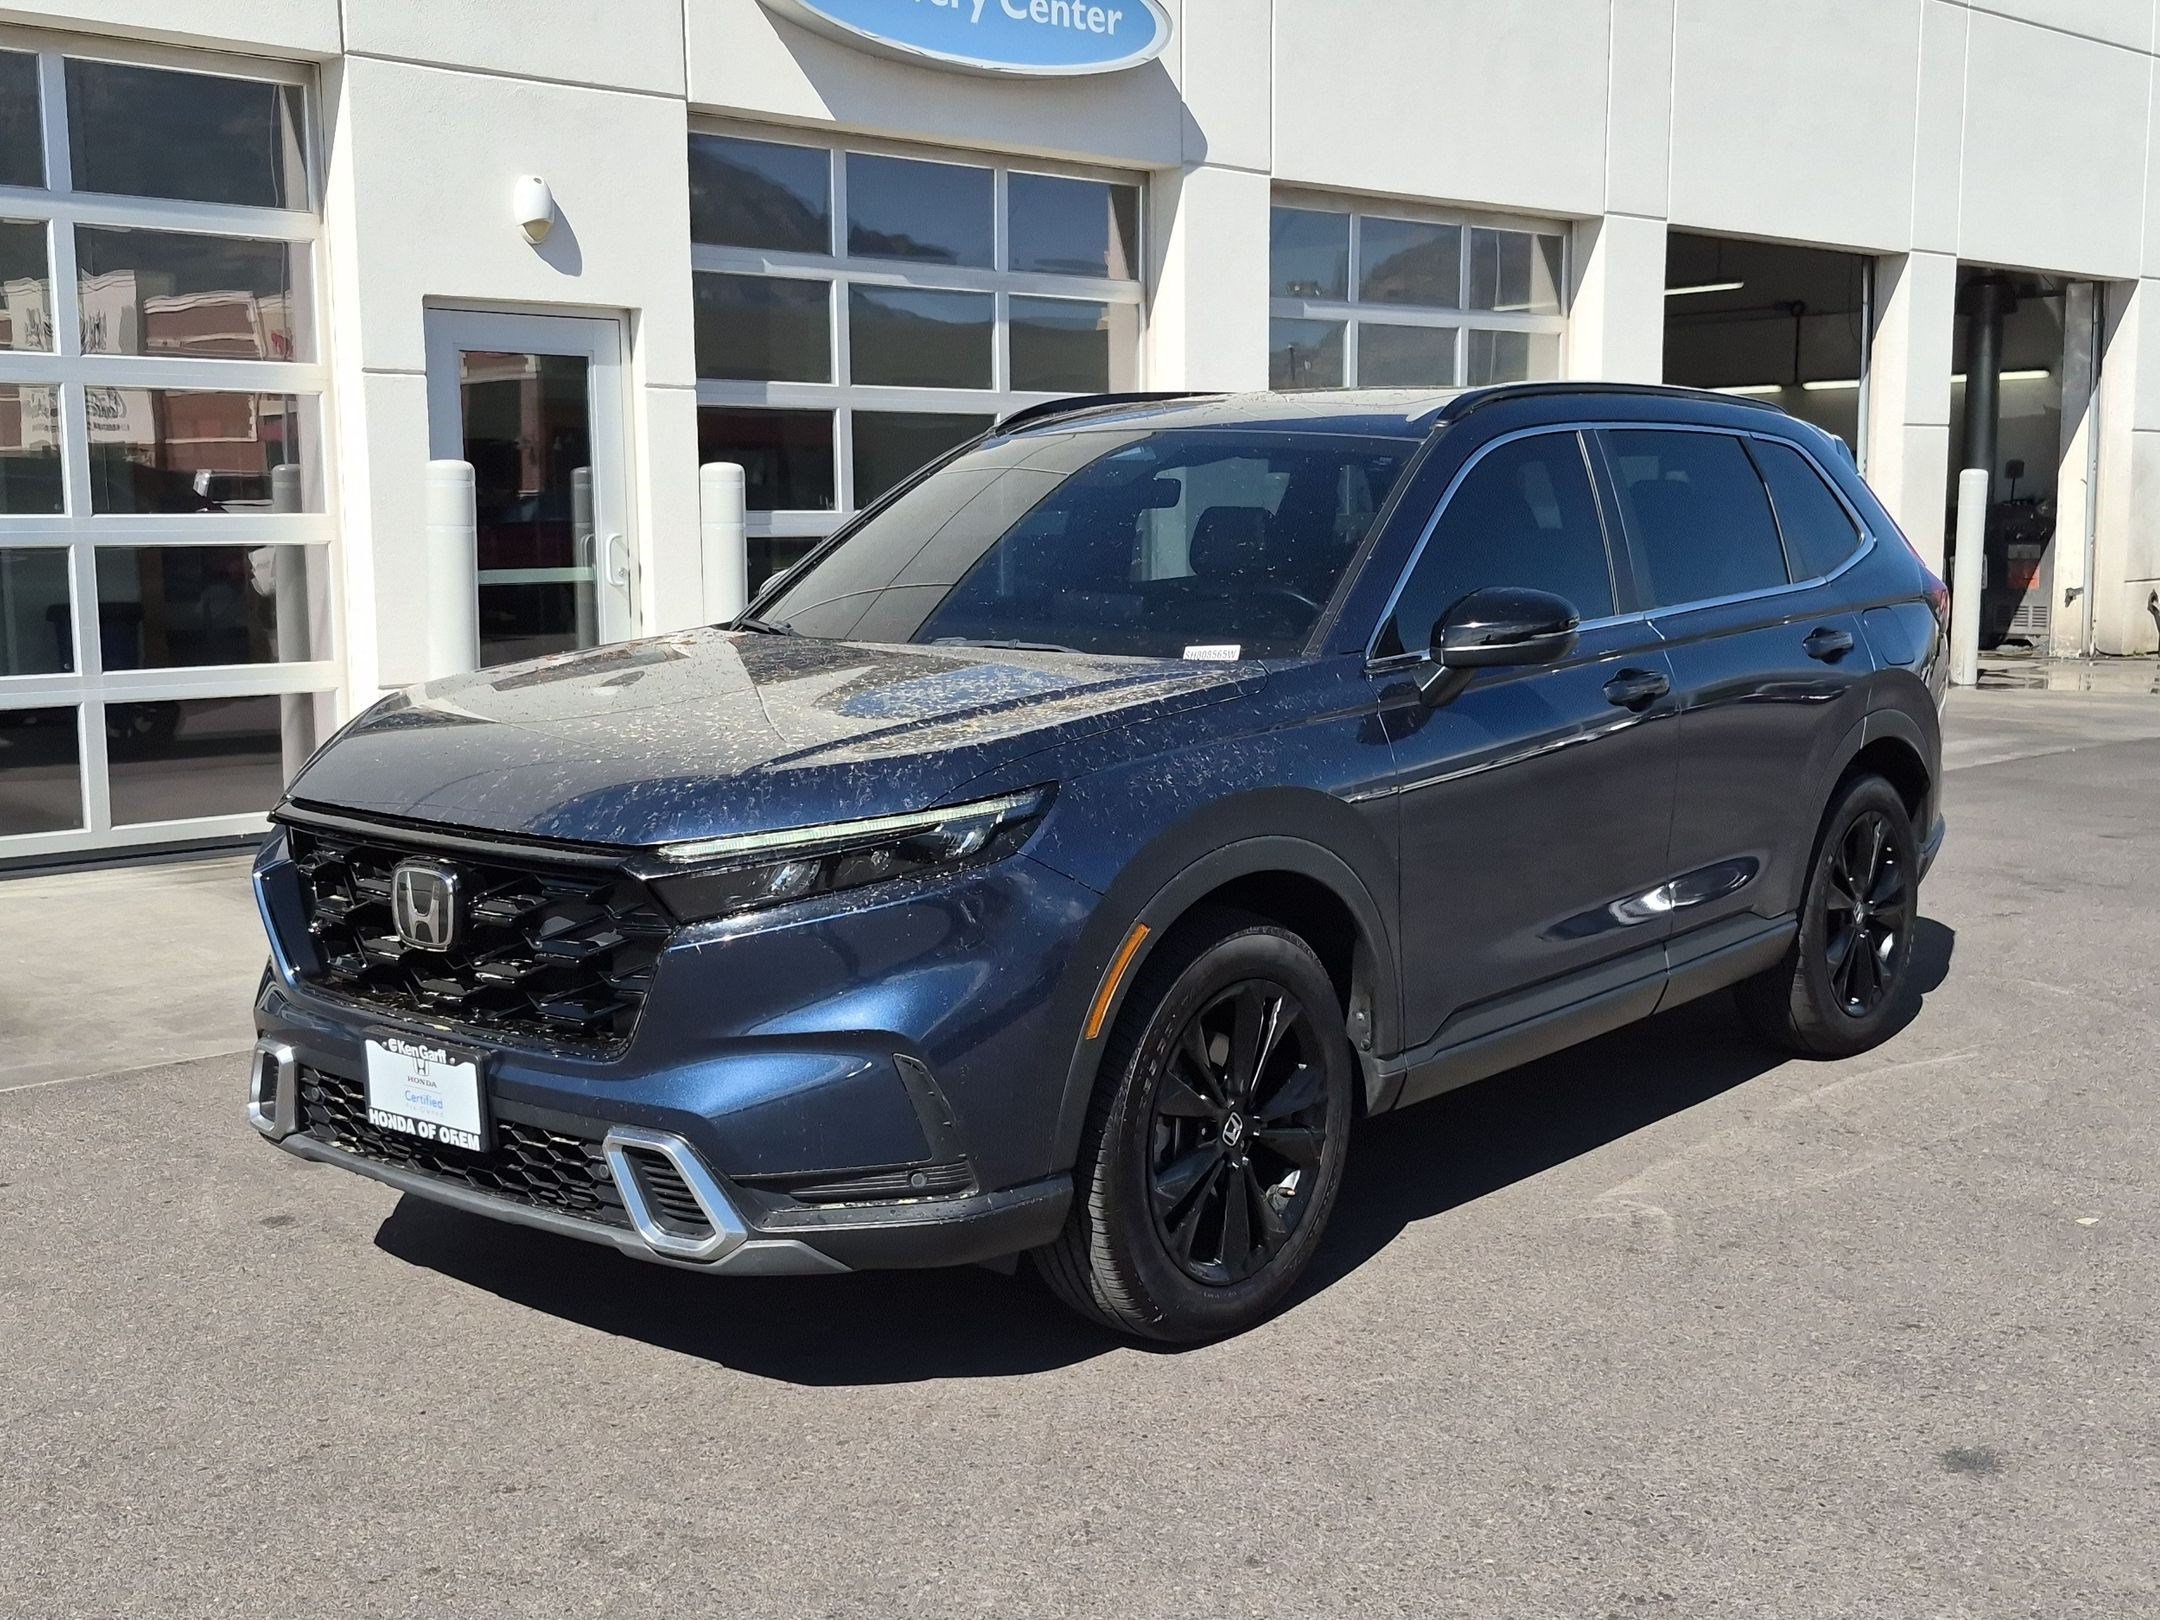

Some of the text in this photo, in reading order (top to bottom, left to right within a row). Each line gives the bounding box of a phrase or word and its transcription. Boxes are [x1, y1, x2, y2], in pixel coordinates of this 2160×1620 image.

[999, 0, 1123, 35] Center
[407, 1076, 437, 1088] HONDA
[405, 1090, 444, 1109] Certified
[368, 1107, 417, 1136] HONDA
[417, 1121, 437, 1140] OF
[439, 1126, 481, 1152] OREM
